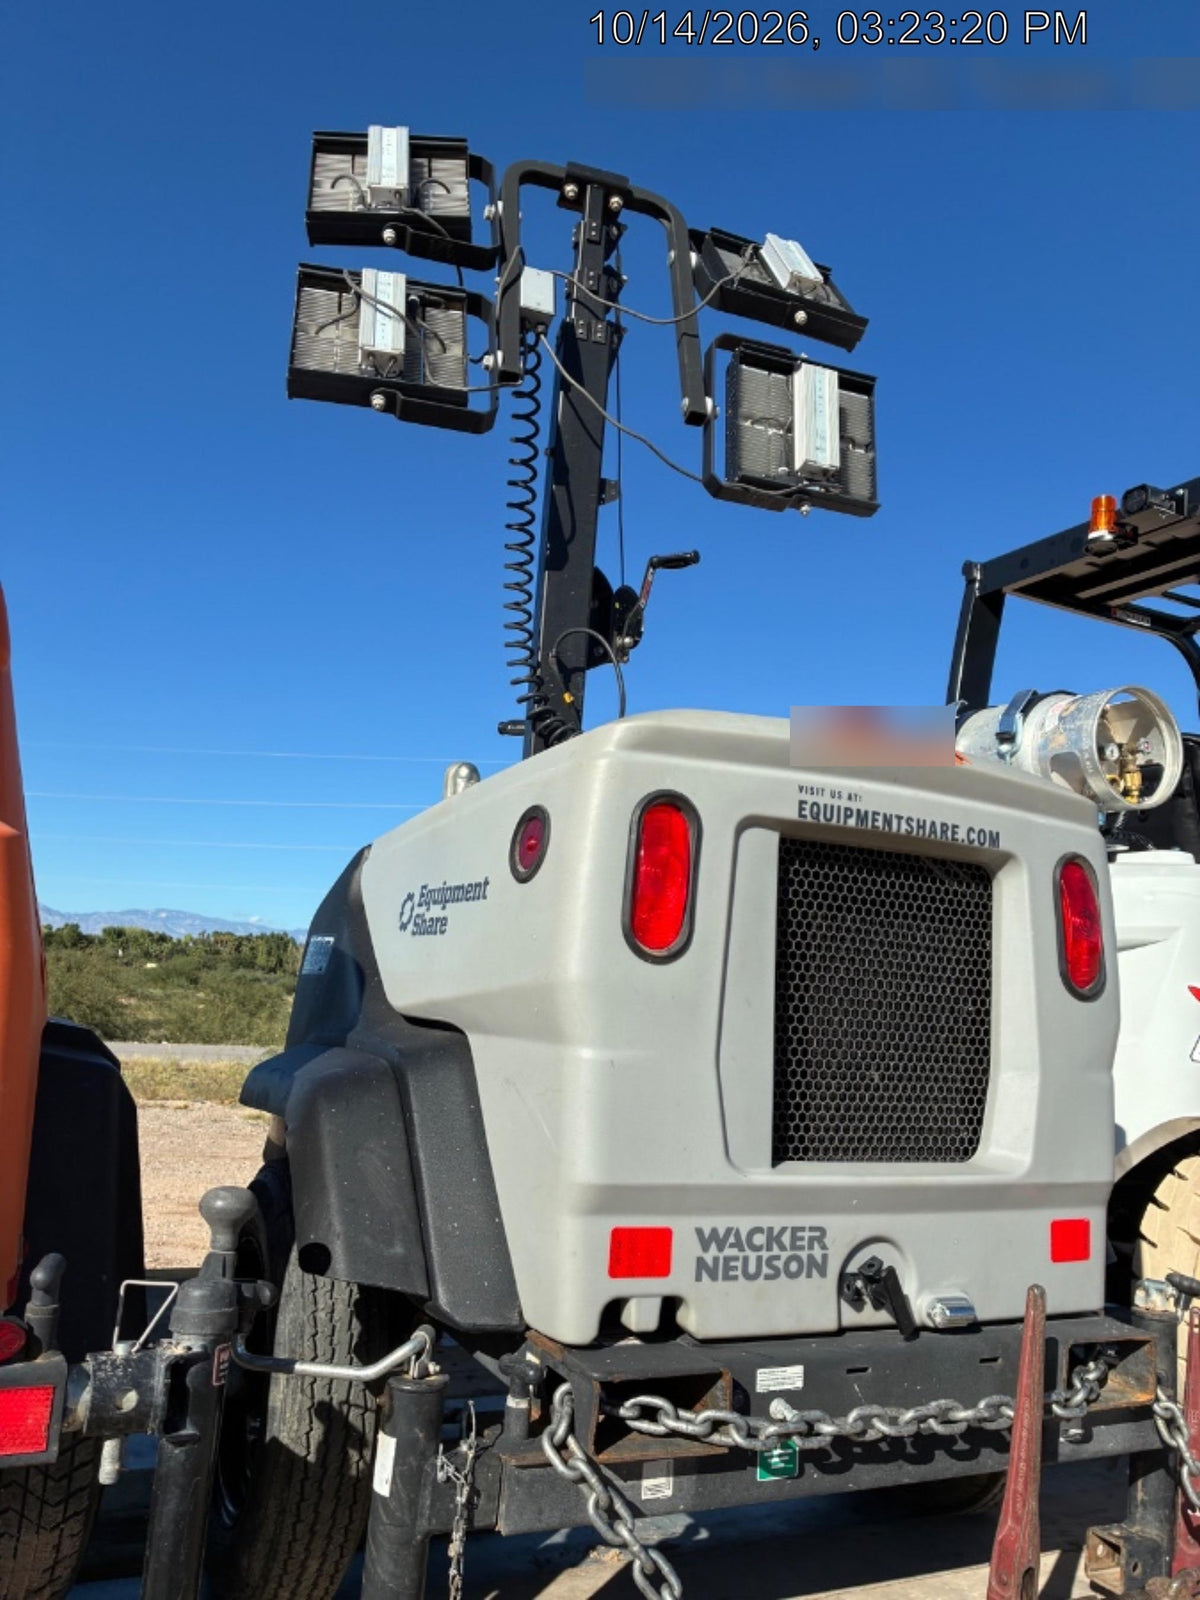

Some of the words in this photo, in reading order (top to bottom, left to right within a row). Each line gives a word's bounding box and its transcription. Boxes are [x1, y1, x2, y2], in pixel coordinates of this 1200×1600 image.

[798, 785, 825, 797] VISIT
[830, 789, 842, 800] US
[797, 799, 1000, 849] EQUIPMENTSHARE.COM
[417, 876, 490, 911] Equipment
[411, 913, 448, 936] Share
[694, 1226, 829, 1253] WACKER
[694, 1253, 829, 1282] NEUSON
